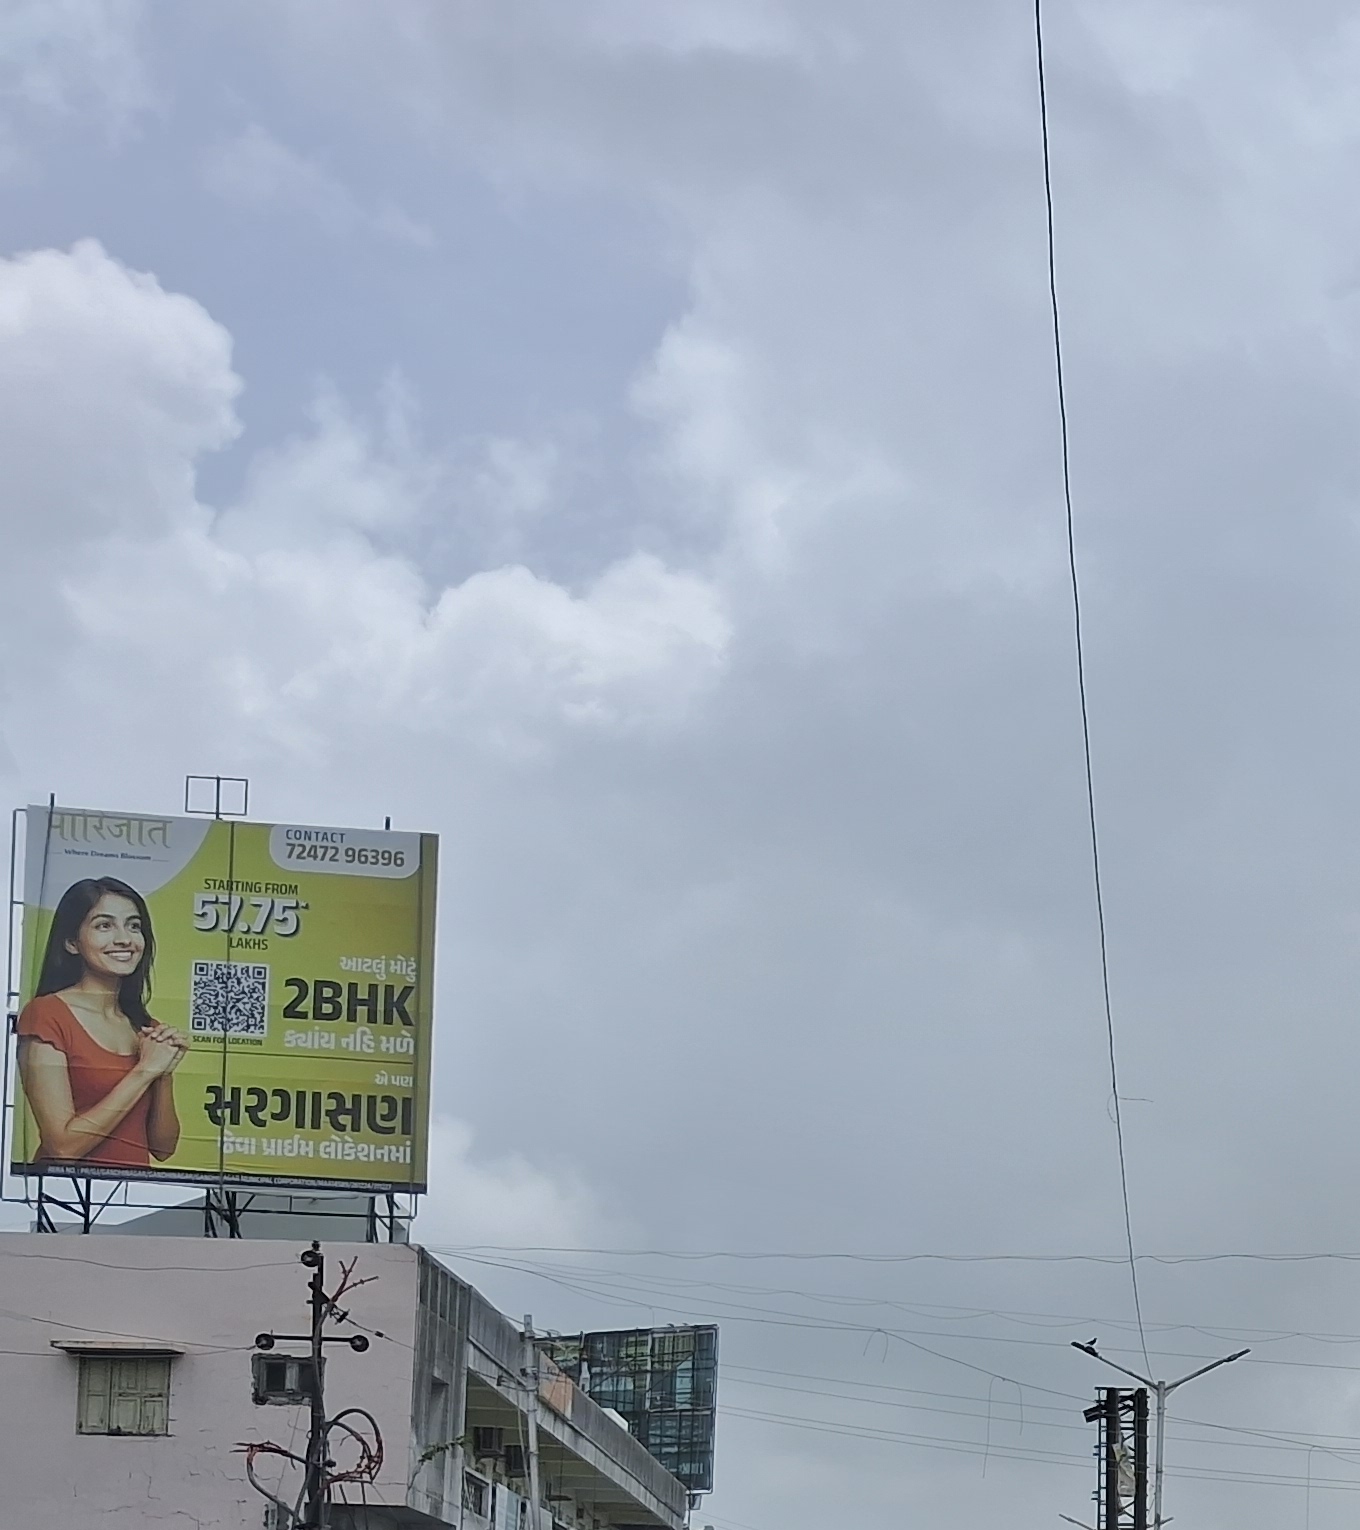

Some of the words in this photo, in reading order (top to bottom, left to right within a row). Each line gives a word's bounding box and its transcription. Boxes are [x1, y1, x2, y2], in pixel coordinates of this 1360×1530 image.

[286, 829, 346, 844] CONTACT
[64, 848, 89, 857] Where
[91, 850, 119, 859] Dreams
[286, 843, 340, 862] 72472
[344, 847, 405, 867] 96396
[204, 879, 262, 893] STARTING
[265, 882, 299, 896] FROM
[229, 937, 269, 951] LAKHS
[340, 956, 387, 981] આટલું
[389, 955, 417, 982] મોટું
[283, 978, 415, 1026] 2BHK
[192, 1035, 211, 1044] SCAN
[228, 1037, 263, 1046] LOCATION
[380, 1030, 415, 1055] મળે
[391, 1073, 414, 1087] પણ
[204, 1085, 413, 1136] સરગાસણ
